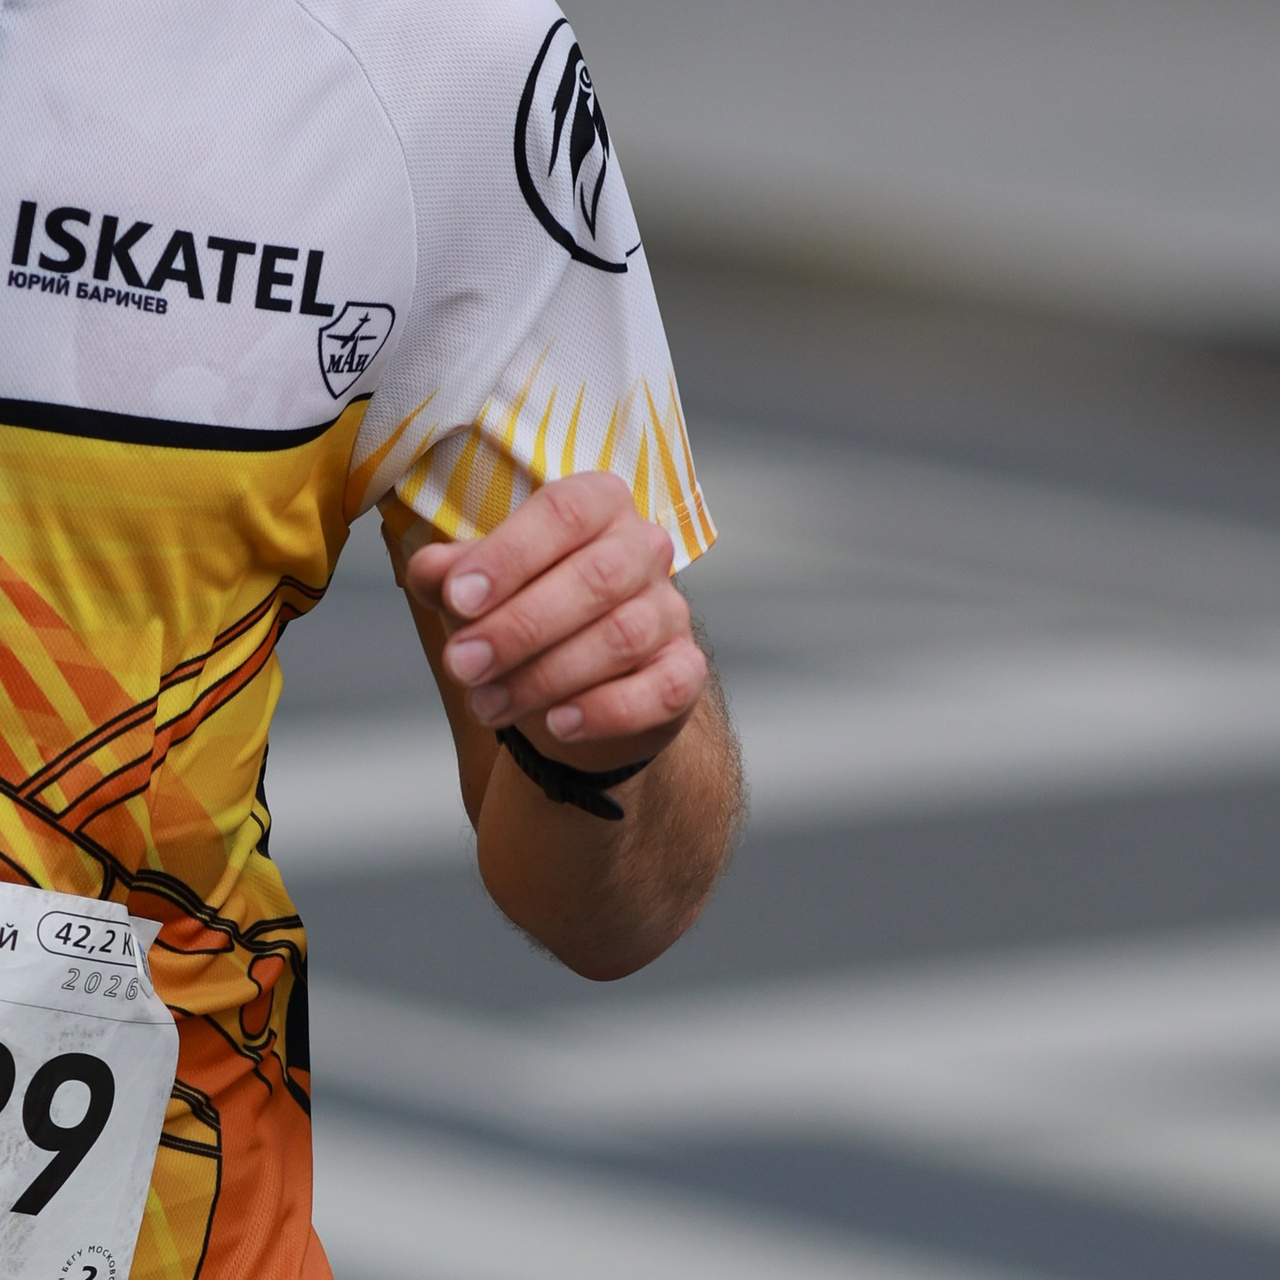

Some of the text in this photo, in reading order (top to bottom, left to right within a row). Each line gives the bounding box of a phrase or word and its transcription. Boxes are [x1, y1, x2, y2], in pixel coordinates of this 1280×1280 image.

[11, 199, 335, 317] ISKATEL
[7, 270, 168, 315] ЮРИЙ БАРИЧЕВ
[54, 922, 116, 954] 42,2
[61, 967, 139, 1000] 2026
[61, 1248, 83, 1273] БЕГУ
